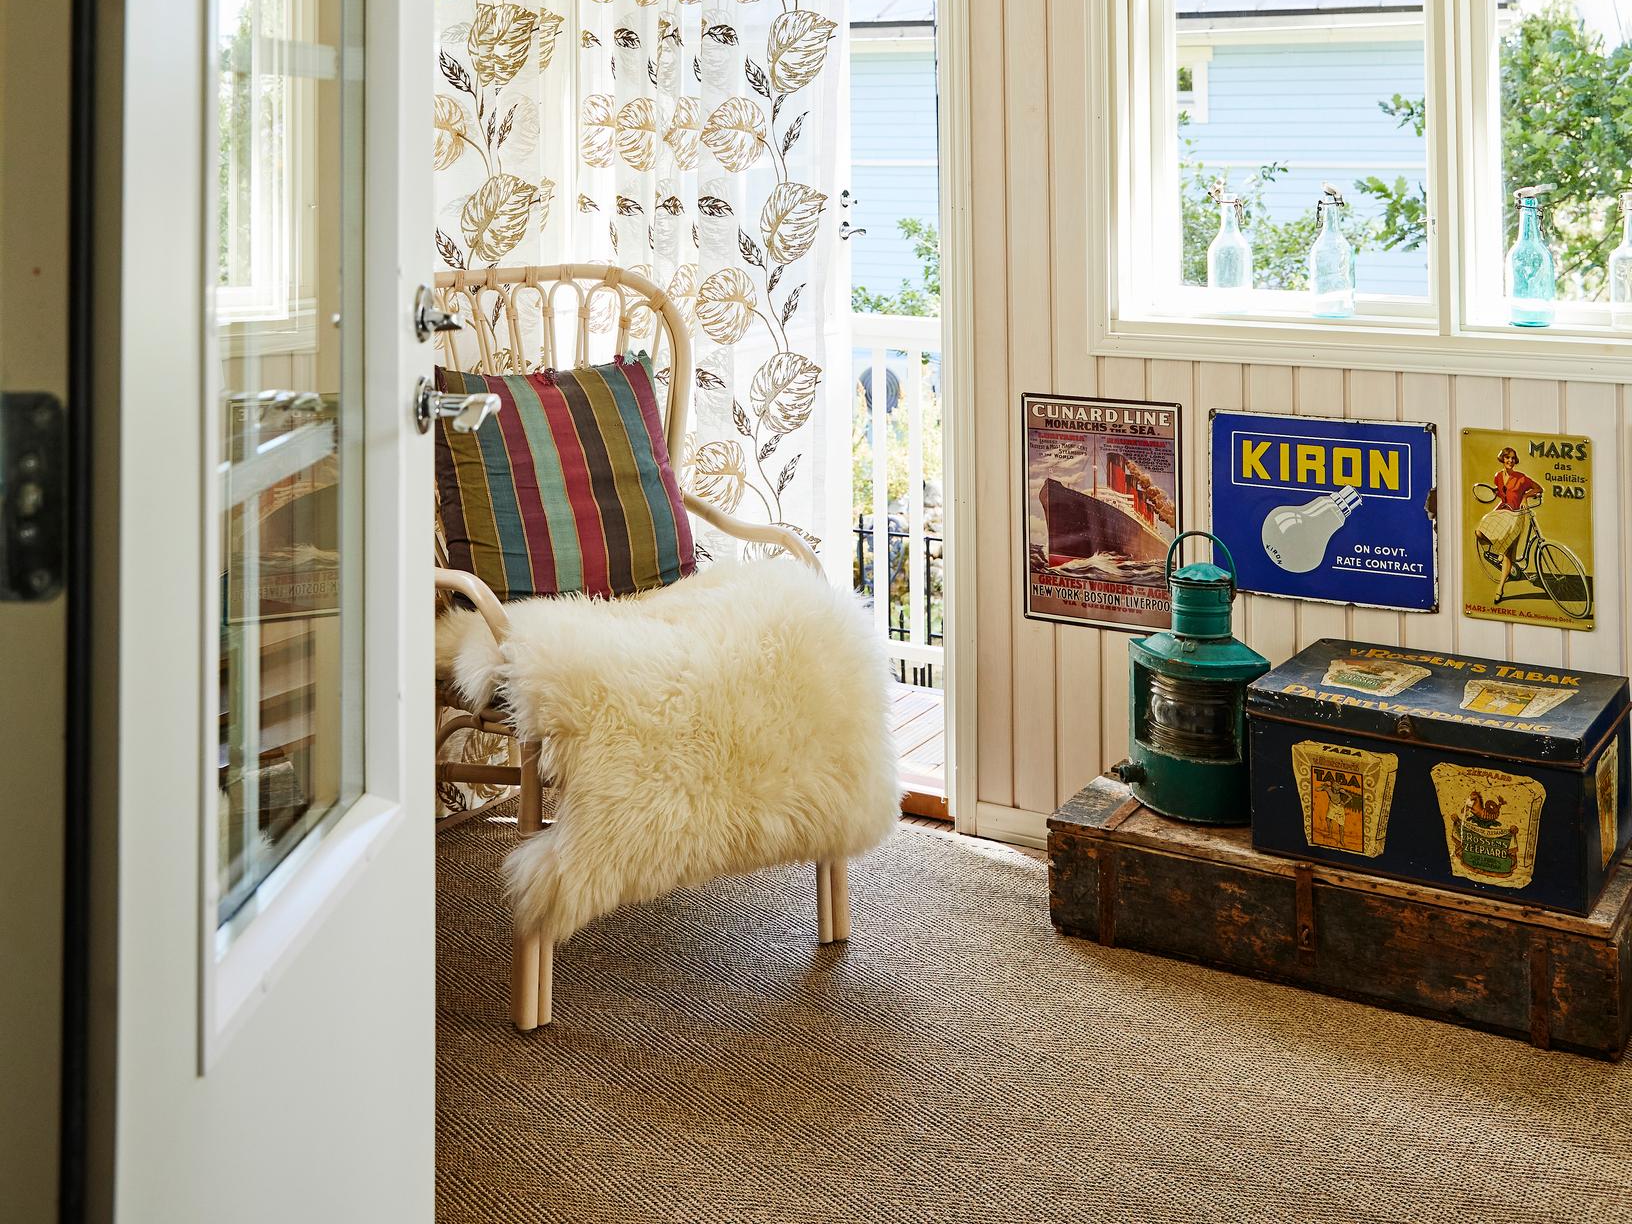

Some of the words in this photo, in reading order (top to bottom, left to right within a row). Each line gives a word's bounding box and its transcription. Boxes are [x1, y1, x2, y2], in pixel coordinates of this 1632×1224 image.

[1032, 404, 1119, 423] CUNARD
[1123, 410, 1171, 427] LINE
[1045, 418, 1107, 433] MONARCHS
[1130, 425, 1161, 436] SEA.
[1529, 440, 1588, 461] MARS
[1242, 439, 1399, 490] KIRON
[1554, 462, 1572, 471] das
[1544, 472, 1588, 484] Qualitäts-
[1552, 484, 1585, 500] RAD
[1266, 544, 1283, 565] KIRON
[1354, 544, 1370, 554] ON
[1374, 546, 1408, 557] GOVT.
[1336, 556, 1362, 567] RATE
[1365, 559, 1424, 573] CONTRACT
[1039, 575, 1088, 589] GREATEST
[1089, 581, 1134, 595] WONDERS
[1032, 584, 1053, 597] NEW
[1056, 588, 1080, 601] YORK
[1084, 591, 1121, 606] BOSTON
[1125, 596, 1172, 612] LIVERPOO
[1495, 665, 1581, 686] TABAK
[1322, 745, 1362, 757] TABA
[1314, 769, 1360, 788] TABA
[1464, 843, 1507, 859] ZEEPAARD
